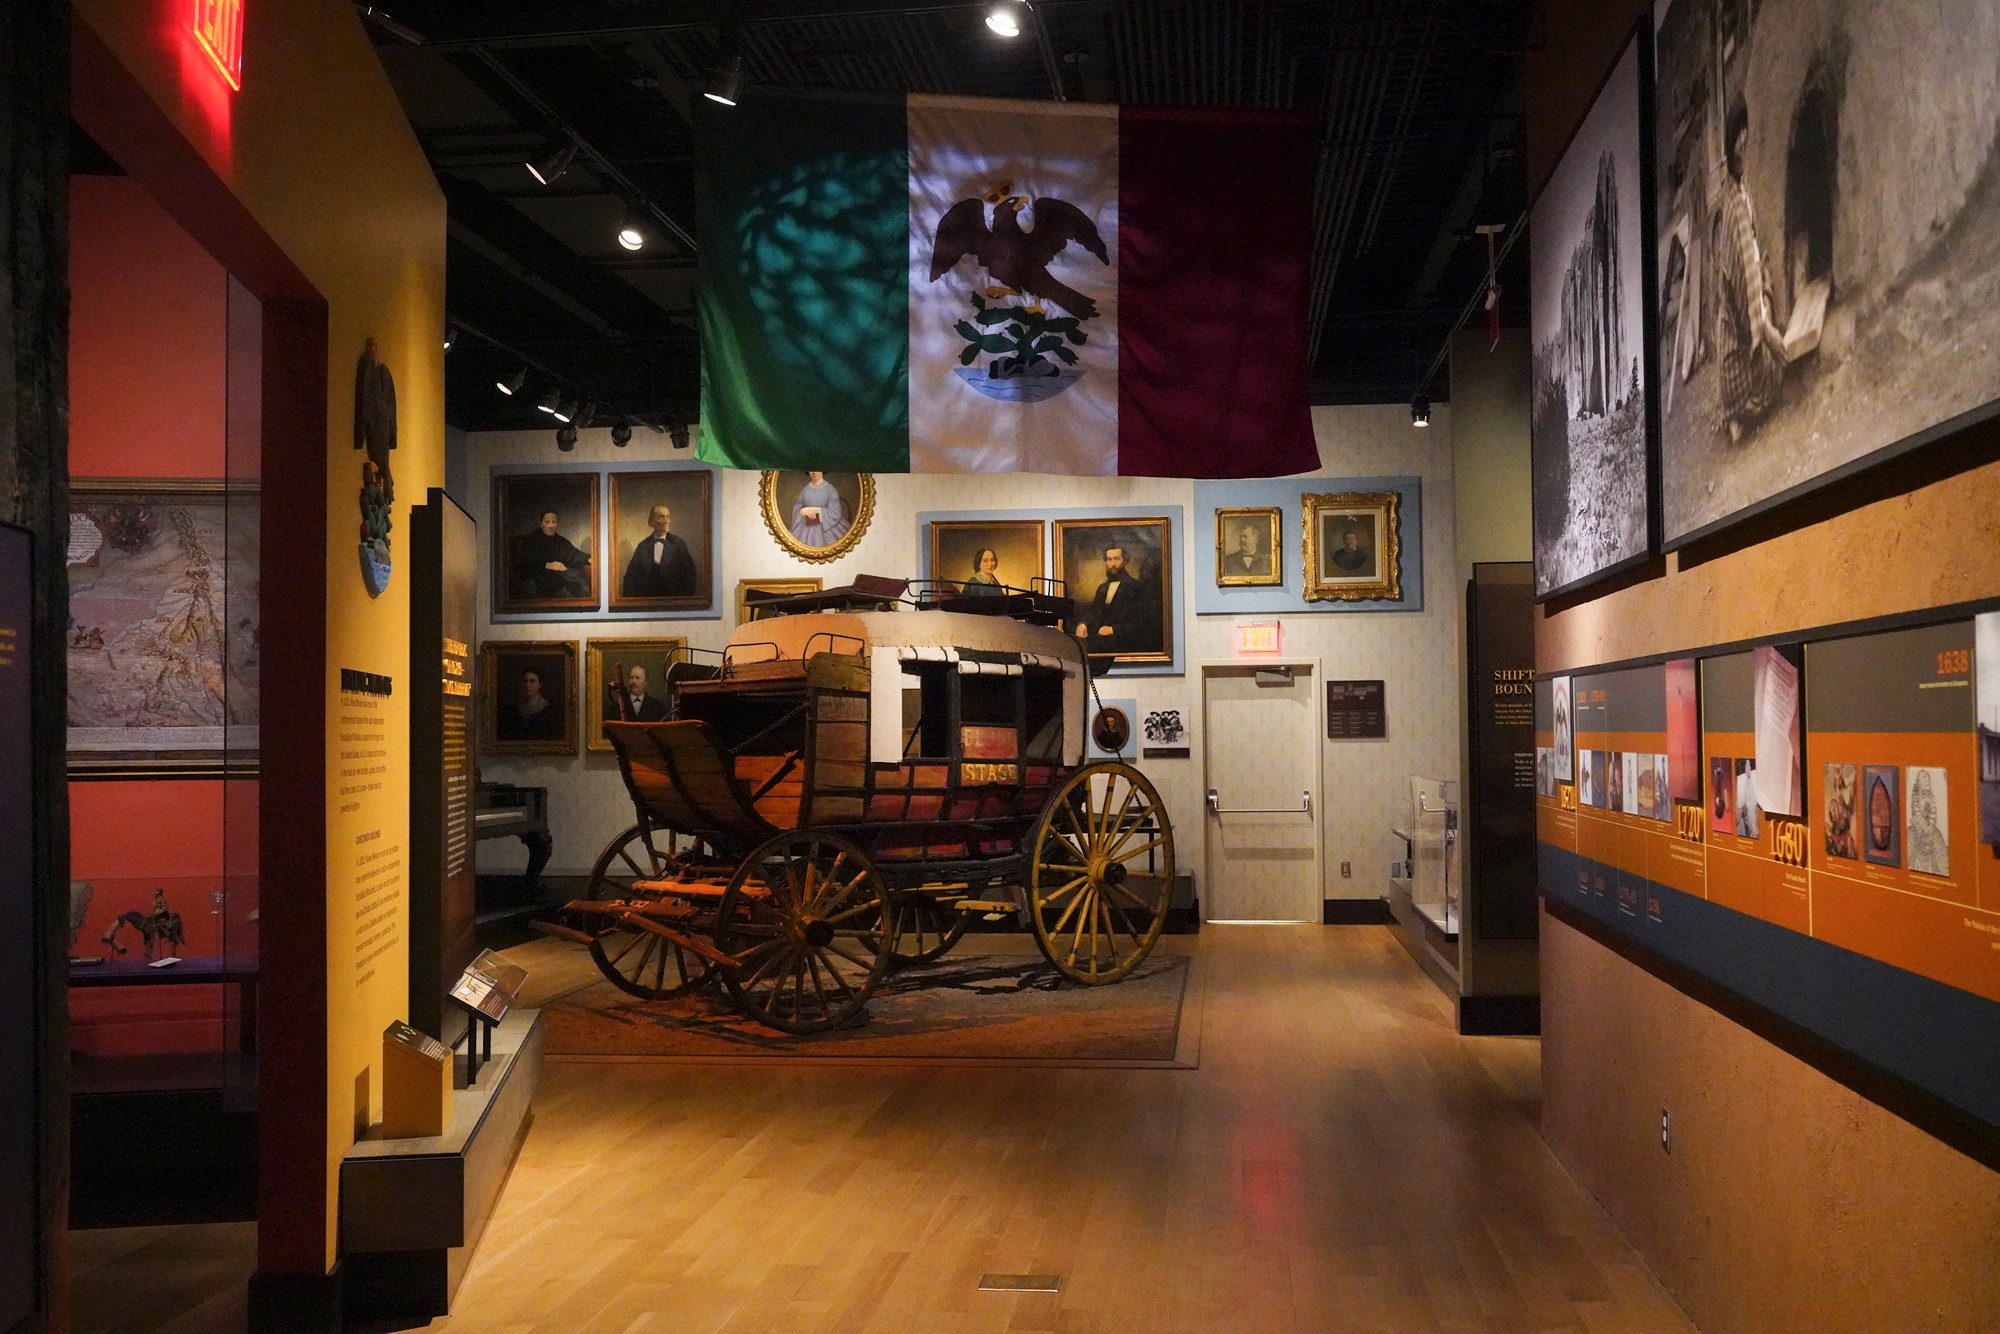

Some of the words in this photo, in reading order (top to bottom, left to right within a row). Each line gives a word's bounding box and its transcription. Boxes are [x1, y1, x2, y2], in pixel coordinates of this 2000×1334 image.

[1243, 627, 1274, 648] EXIT
[1936, 649, 1969, 675] 1638
[1494, 669, 1535, 681] SHIFT
[965, 763, 1017, 782] STAGE
[1769, 819, 1803, 862] 1680
